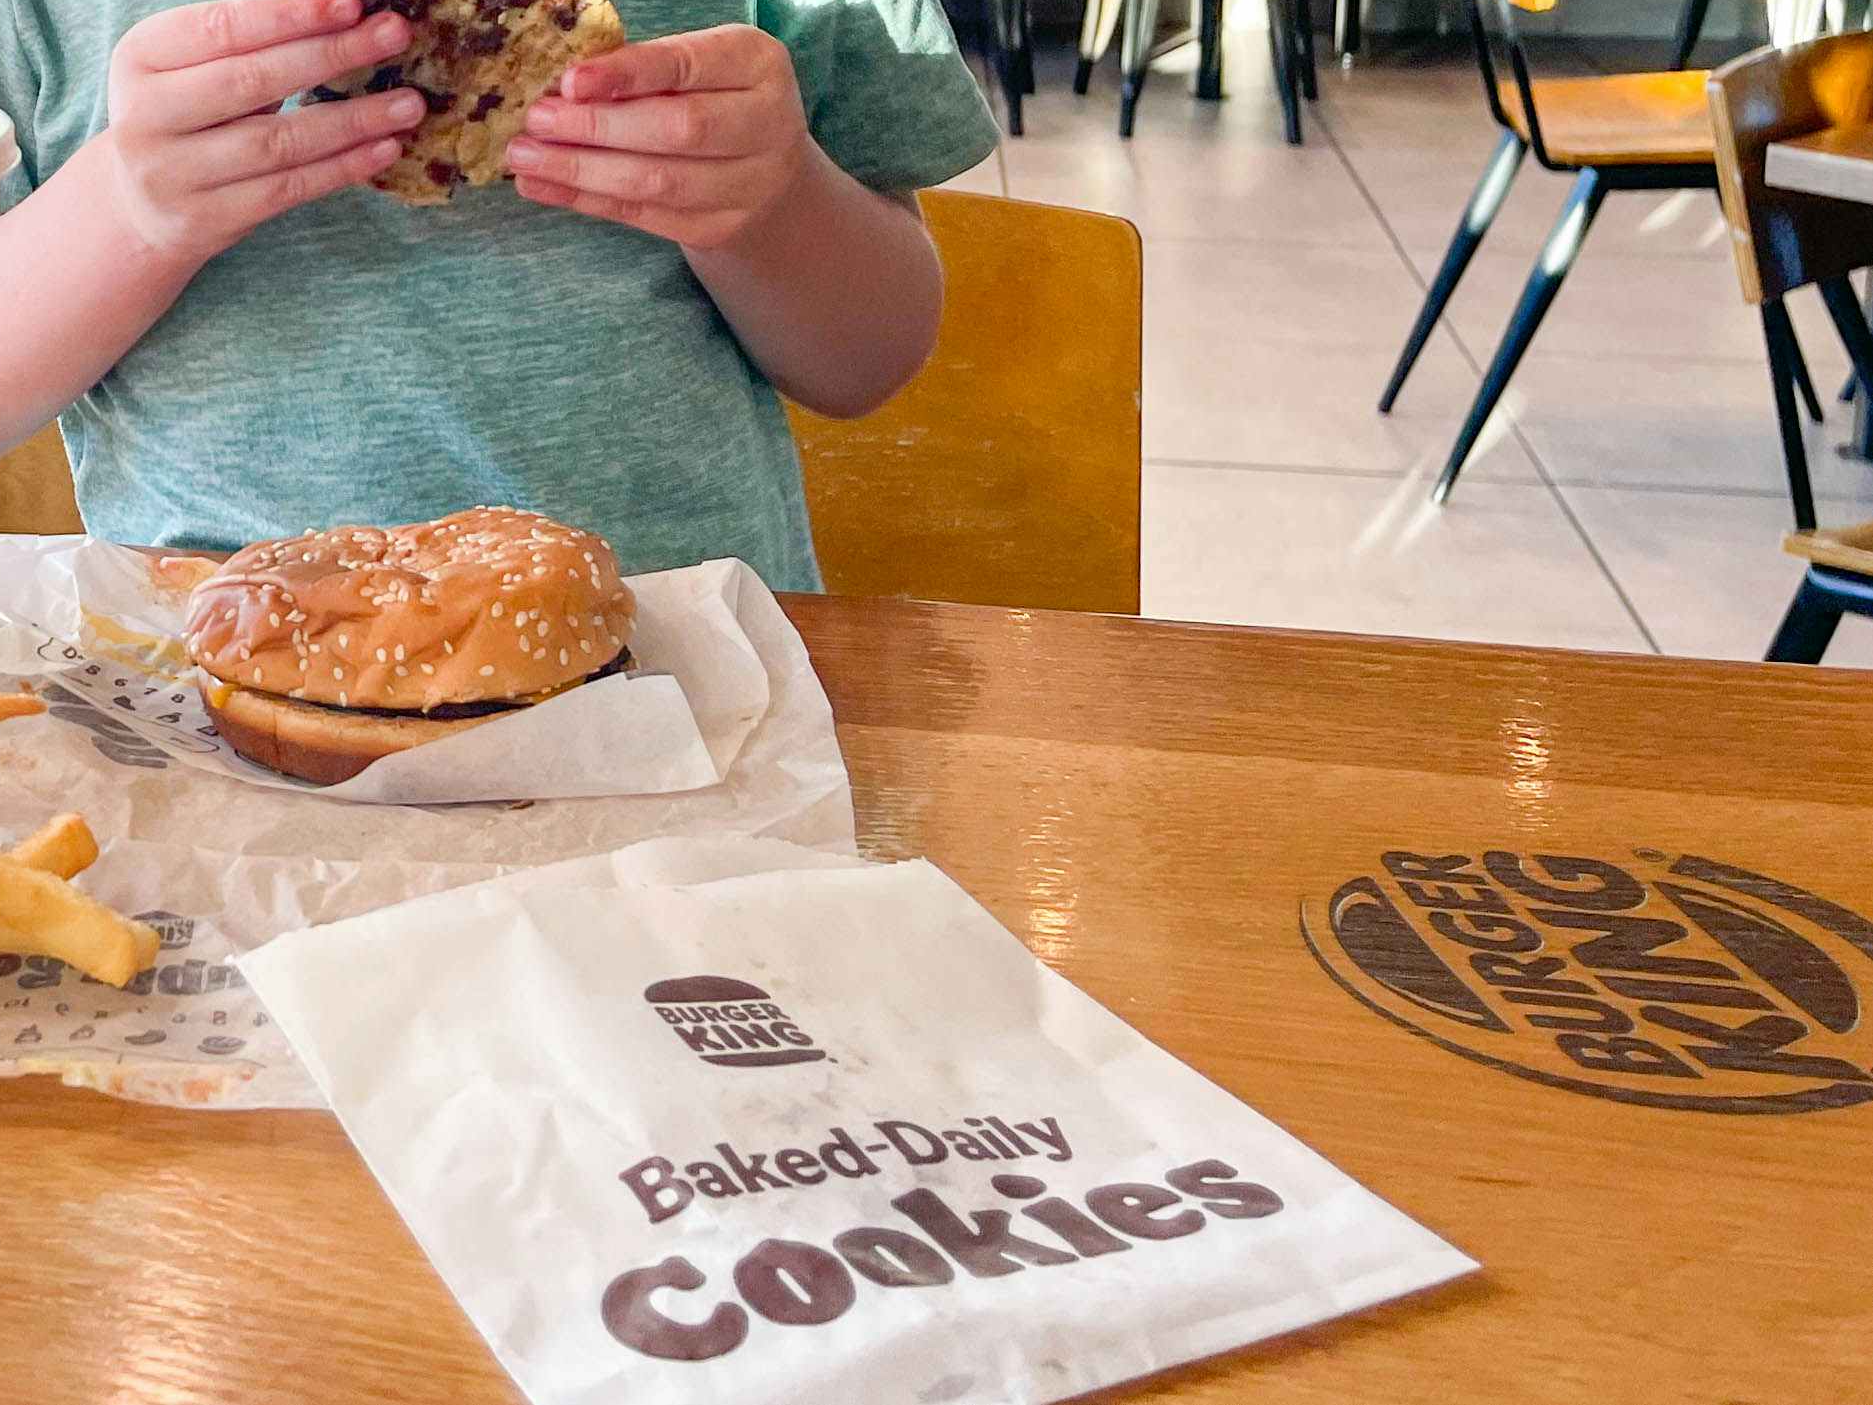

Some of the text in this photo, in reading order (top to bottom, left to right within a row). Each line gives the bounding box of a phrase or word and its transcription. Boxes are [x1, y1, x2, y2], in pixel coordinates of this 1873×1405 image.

[654, 1003, 791, 1025] BURGER
[1381, 850, 1705, 1080] BURGER
[1483, 850, 1873, 1082] KING
[673, 1021, 814, 1052] KING
[619, 1114, 1074, 1224] Baked-Daily
